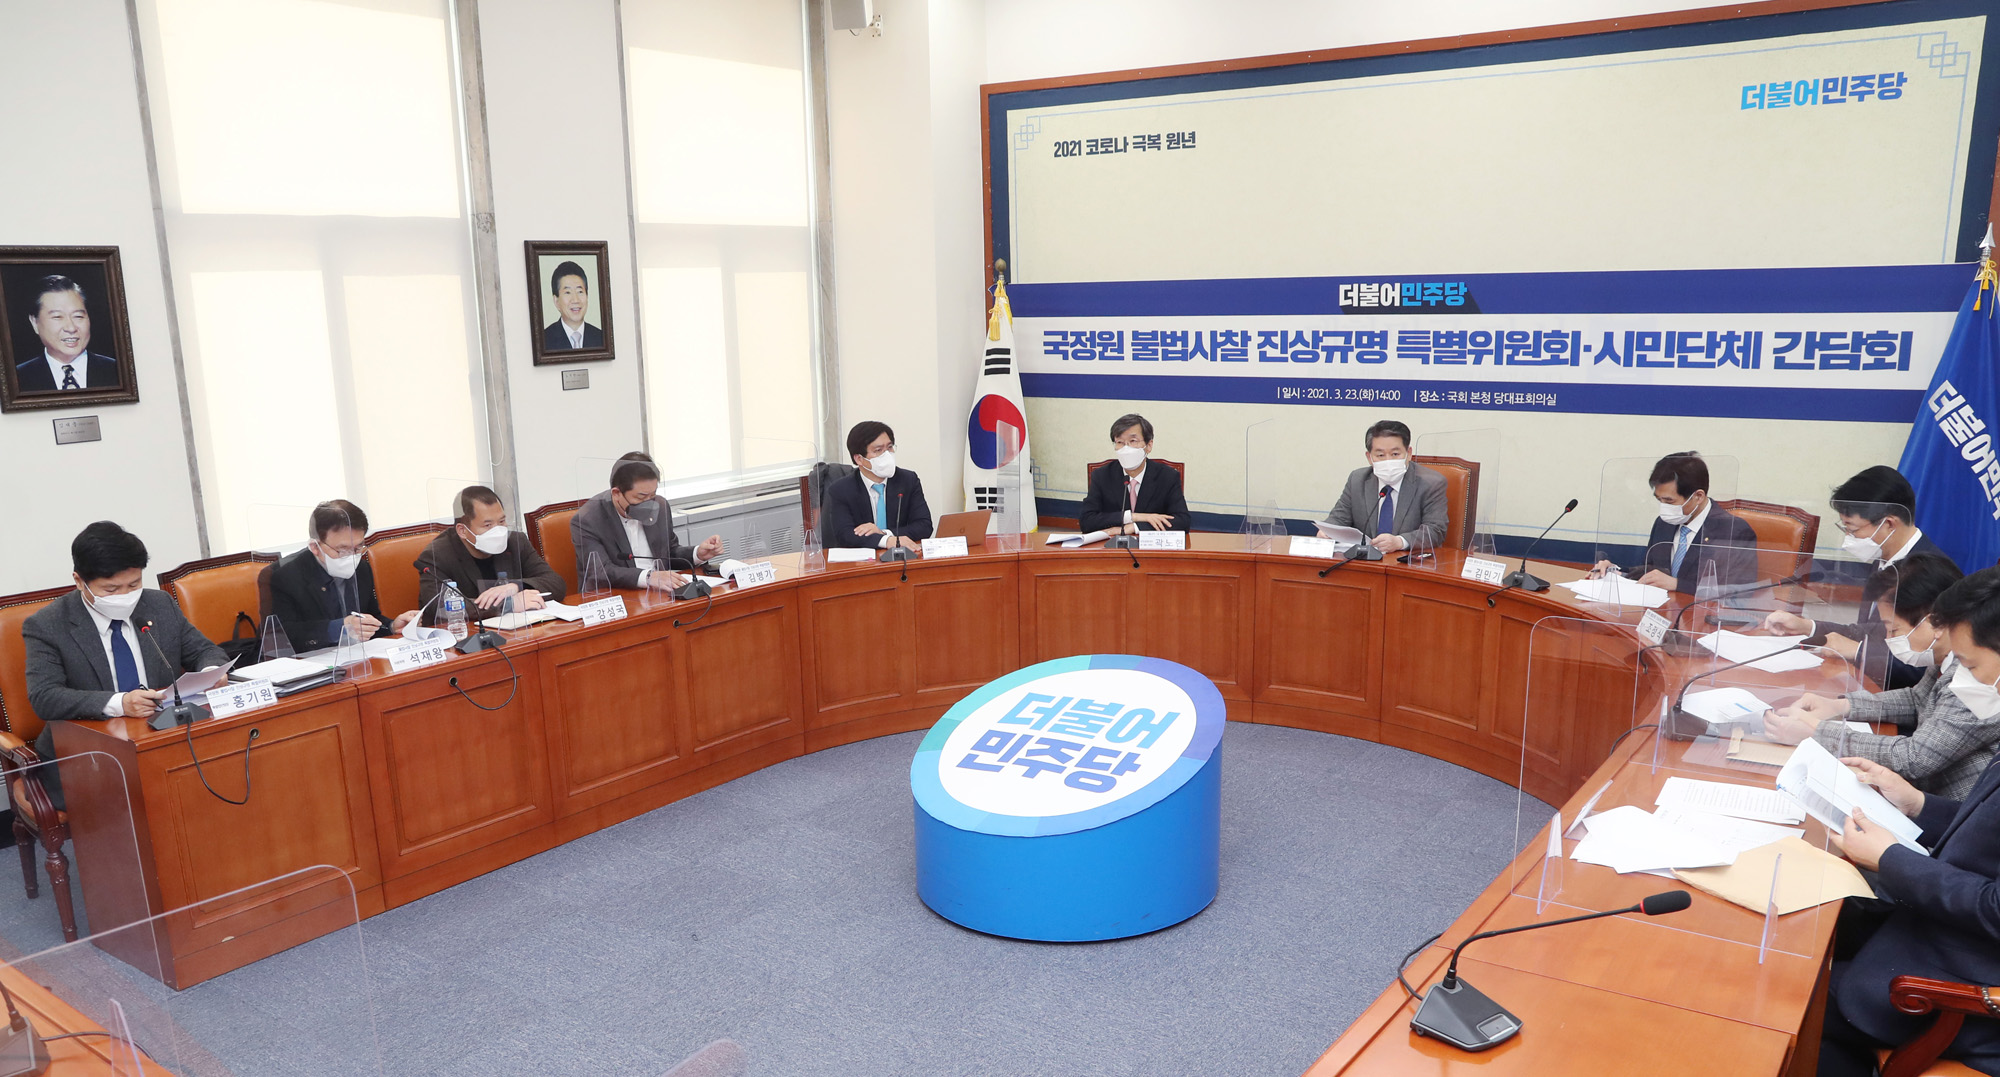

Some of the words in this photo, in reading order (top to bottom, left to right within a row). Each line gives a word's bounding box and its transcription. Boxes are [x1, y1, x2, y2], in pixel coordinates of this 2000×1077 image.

[1741, 71, 1908, 110] 더불어민주당
[1053, 140, 1082, 158] 2021
[1085, 136, 1129, 156] 코로나
[1132, 133, 1162, 152] 극복
[1166, 131, 1196, 150] 원년
[1339, 282, 1468, 307] 더불어민주당
[1043, 330, 1125, 361] 국정원
[1131, 330, 1252, 362] 불법사찰
[1257, 330, 1388, 364] 진상규명
[1772, 330, 1914, 371] 간담회
[1307, 388, 1333, 399] 2021.
[1447, 391, 1468, 403] 국회
[1469, 391, 1492, 404] 본청
[1494, 392, 1557, 406] 당대표회의실
[748, 569, 773, 583] 김병기
[1475, 567, 1501, 582] 김민기
[596, 604, 625, 620] 강성국
[410, 646, 443, 664] 석재왕
[233, 687, 273, 709] 홍기원
[997, 692, 1181, 749] 더불어
[955, 729, 1142, 793] 민주당
